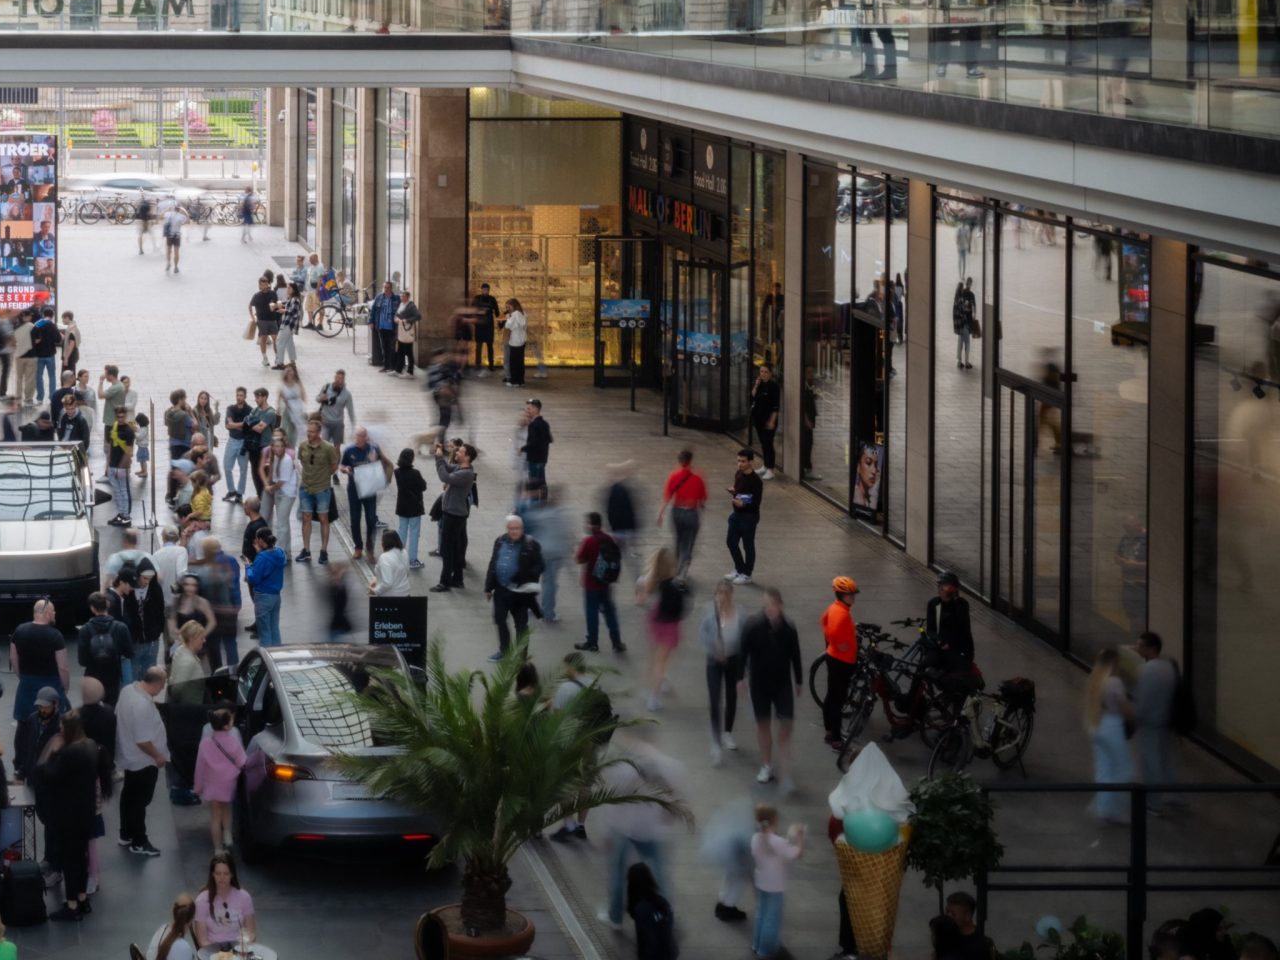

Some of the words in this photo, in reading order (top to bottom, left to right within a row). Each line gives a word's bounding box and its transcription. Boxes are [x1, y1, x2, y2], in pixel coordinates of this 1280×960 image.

[628, 185, 653, 218] MALL
[656, 195, 671, 224] OF
[674, 199, 712, 241] BERLIN
[7, 286, 35, 294] GRUND
[374, 630, 386, 638] Sie
[388, 630, 407, 638] Tesla
